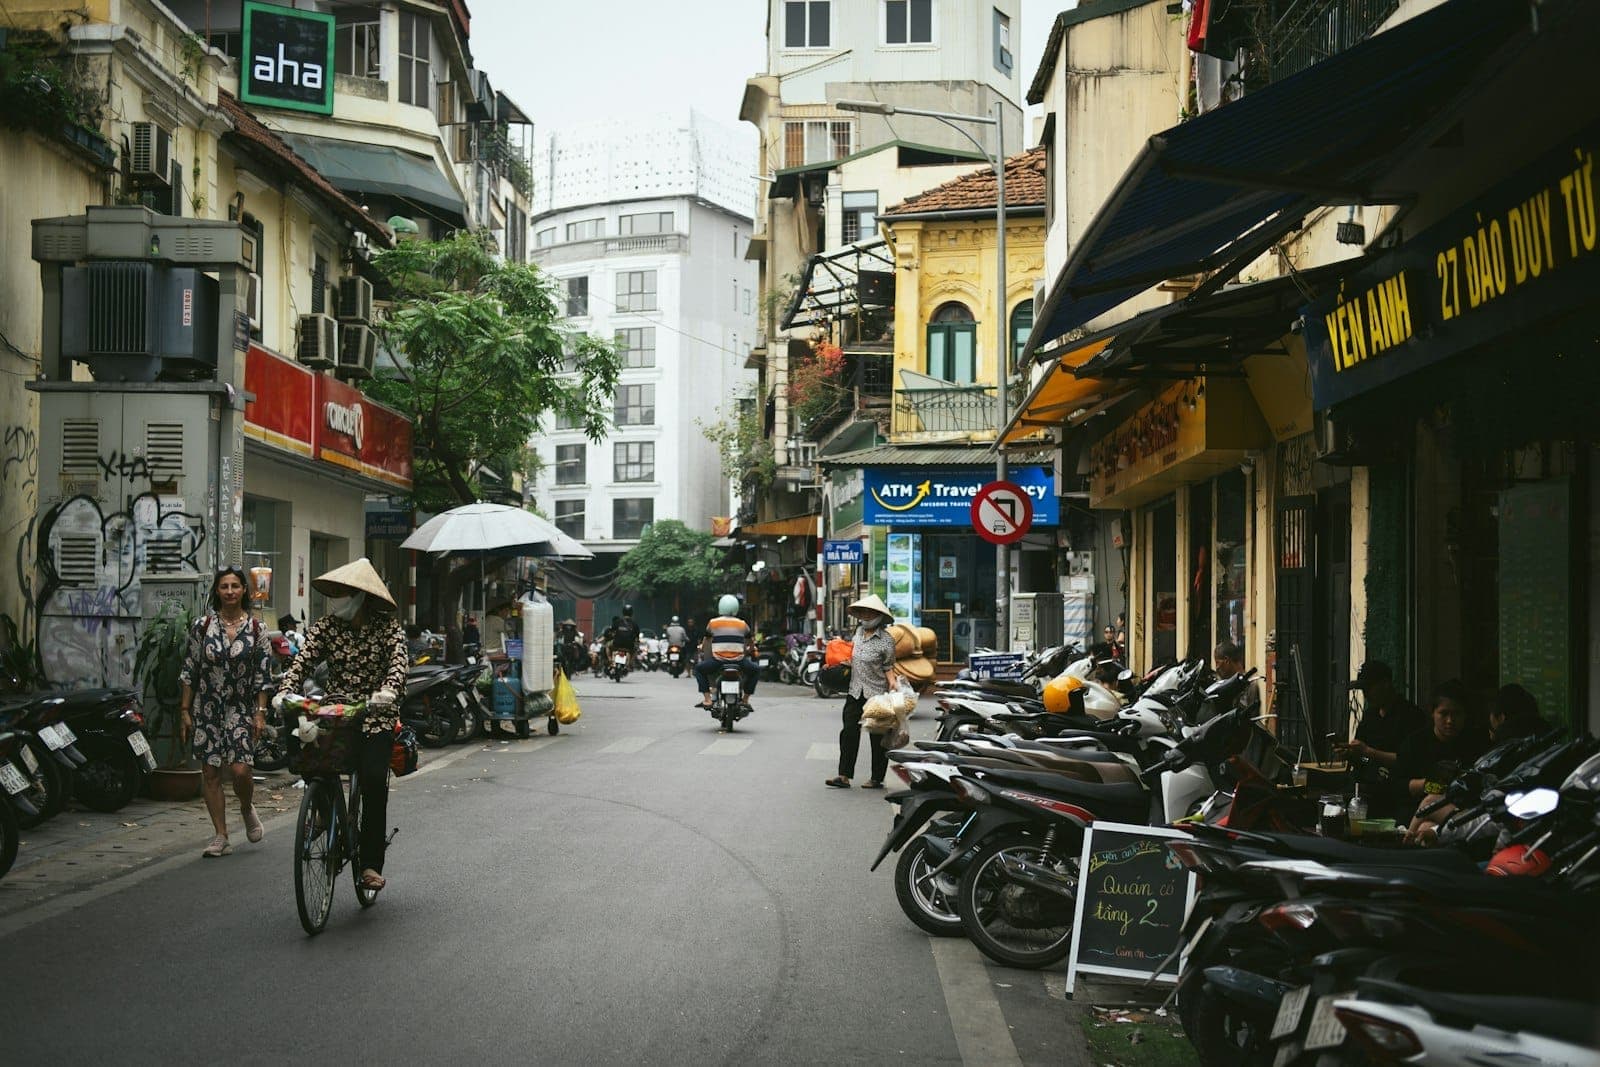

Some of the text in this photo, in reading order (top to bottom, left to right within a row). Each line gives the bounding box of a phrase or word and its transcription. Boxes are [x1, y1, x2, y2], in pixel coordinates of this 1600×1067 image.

[254, 43, 322, 89] aha
[1326, 147, 1596, 372] YẾN ANH 27 ĐÀO DUY TỪ
[327, 401, 355, 435] CIRCLE
[880, 484, 913, 498] ATM
[1101, 874, 1175, 896] Quán có
[1093, 898, 1161, 936] tầng 2
